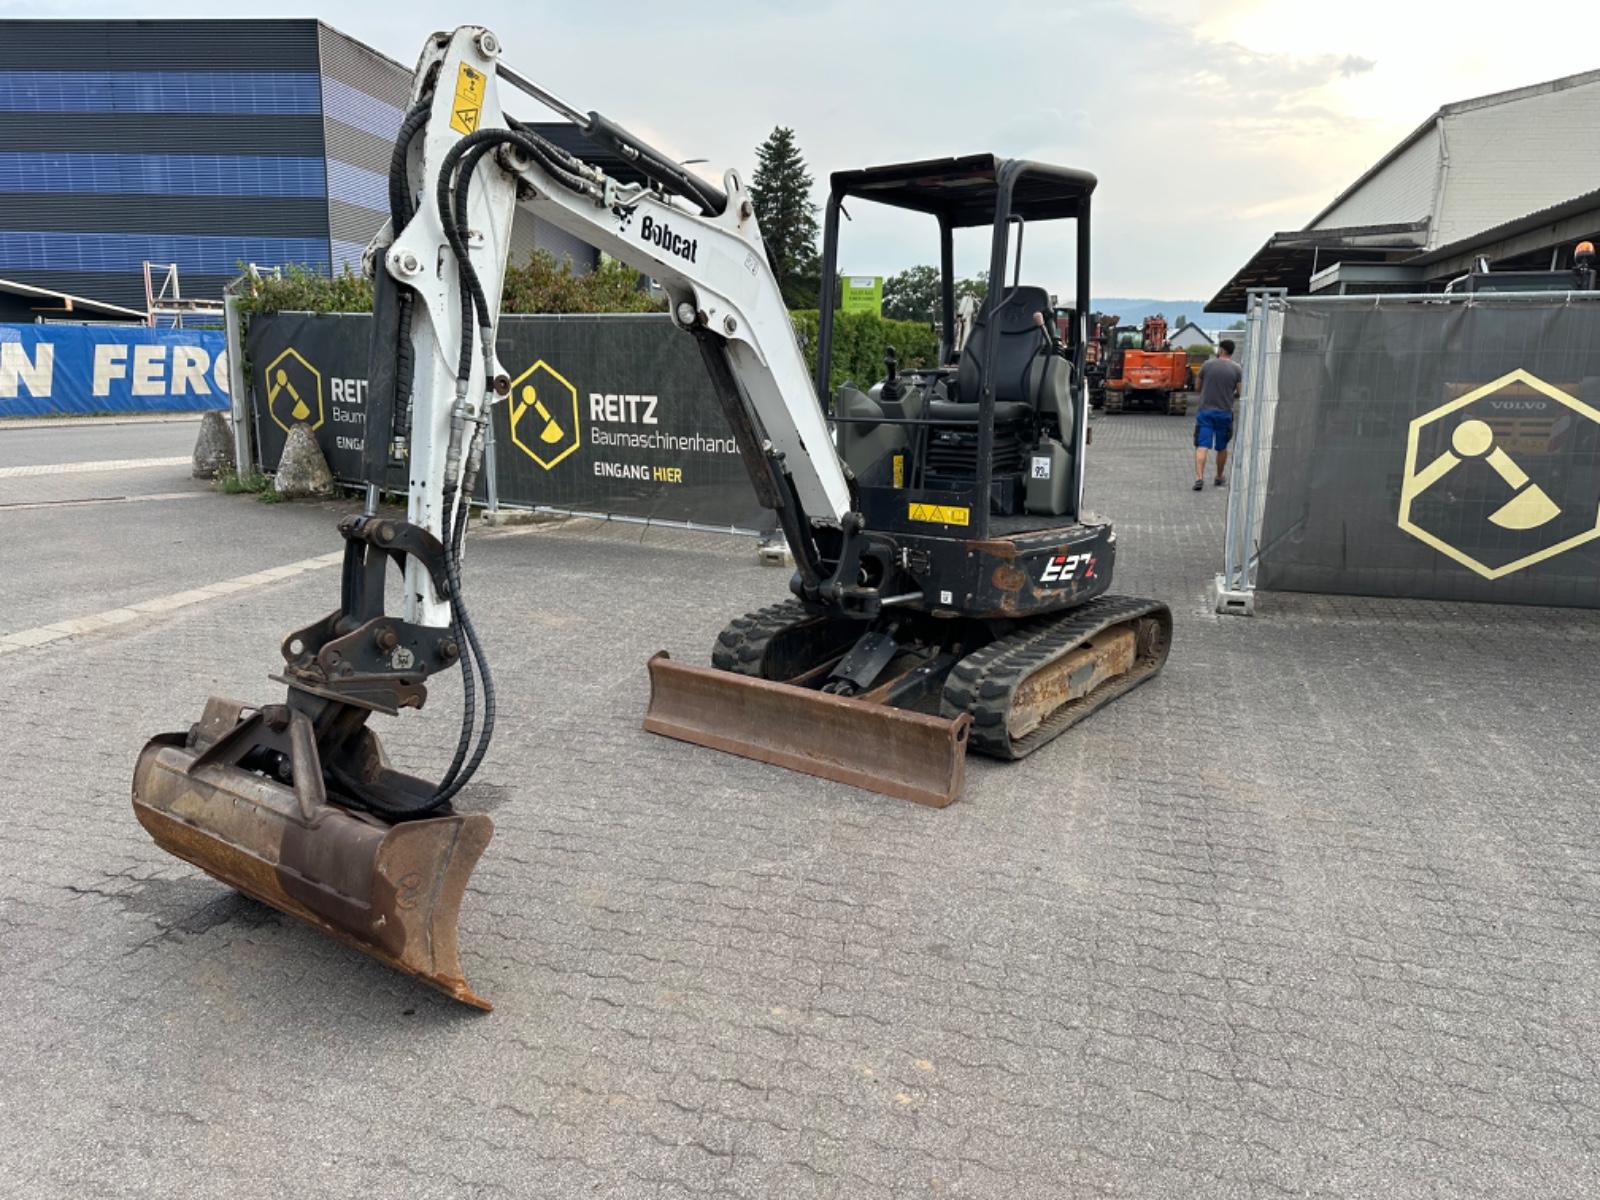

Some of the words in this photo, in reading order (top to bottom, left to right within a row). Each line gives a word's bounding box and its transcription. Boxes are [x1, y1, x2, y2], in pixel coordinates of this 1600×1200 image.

[641, 215, 697, 263] Bobcat
[589, 393, 658, 424] REITZ
[1490, 400, 1547, 410] VOLVO
[593, 461, 649, 480] EINGANG
[653, 467, 682, 483] HIER
